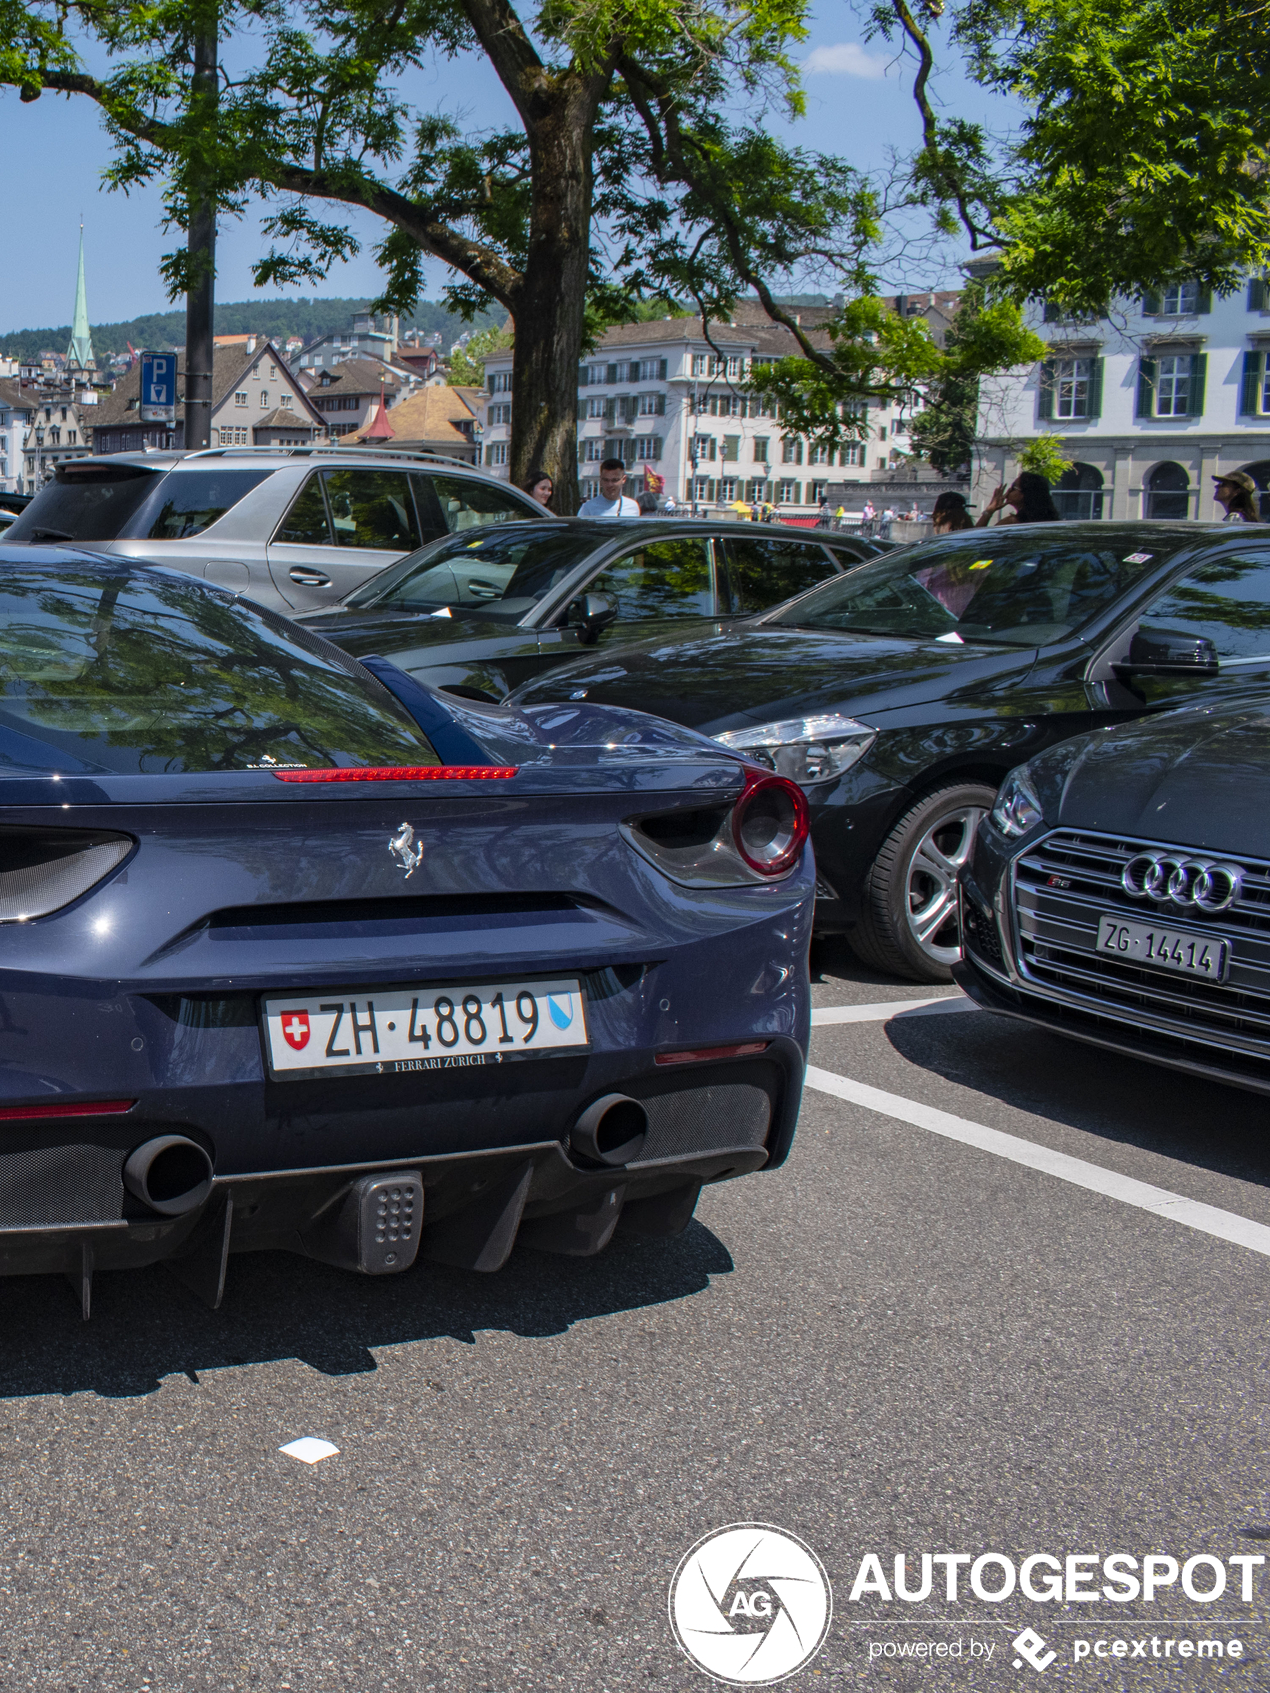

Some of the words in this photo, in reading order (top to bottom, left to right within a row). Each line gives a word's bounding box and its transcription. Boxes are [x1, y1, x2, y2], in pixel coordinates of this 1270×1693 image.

[152, 359, 166, 382] P
[394, 1059, 441, 1072] FERRARI
[443, 1054, 486, 1068] ZÜRICH
